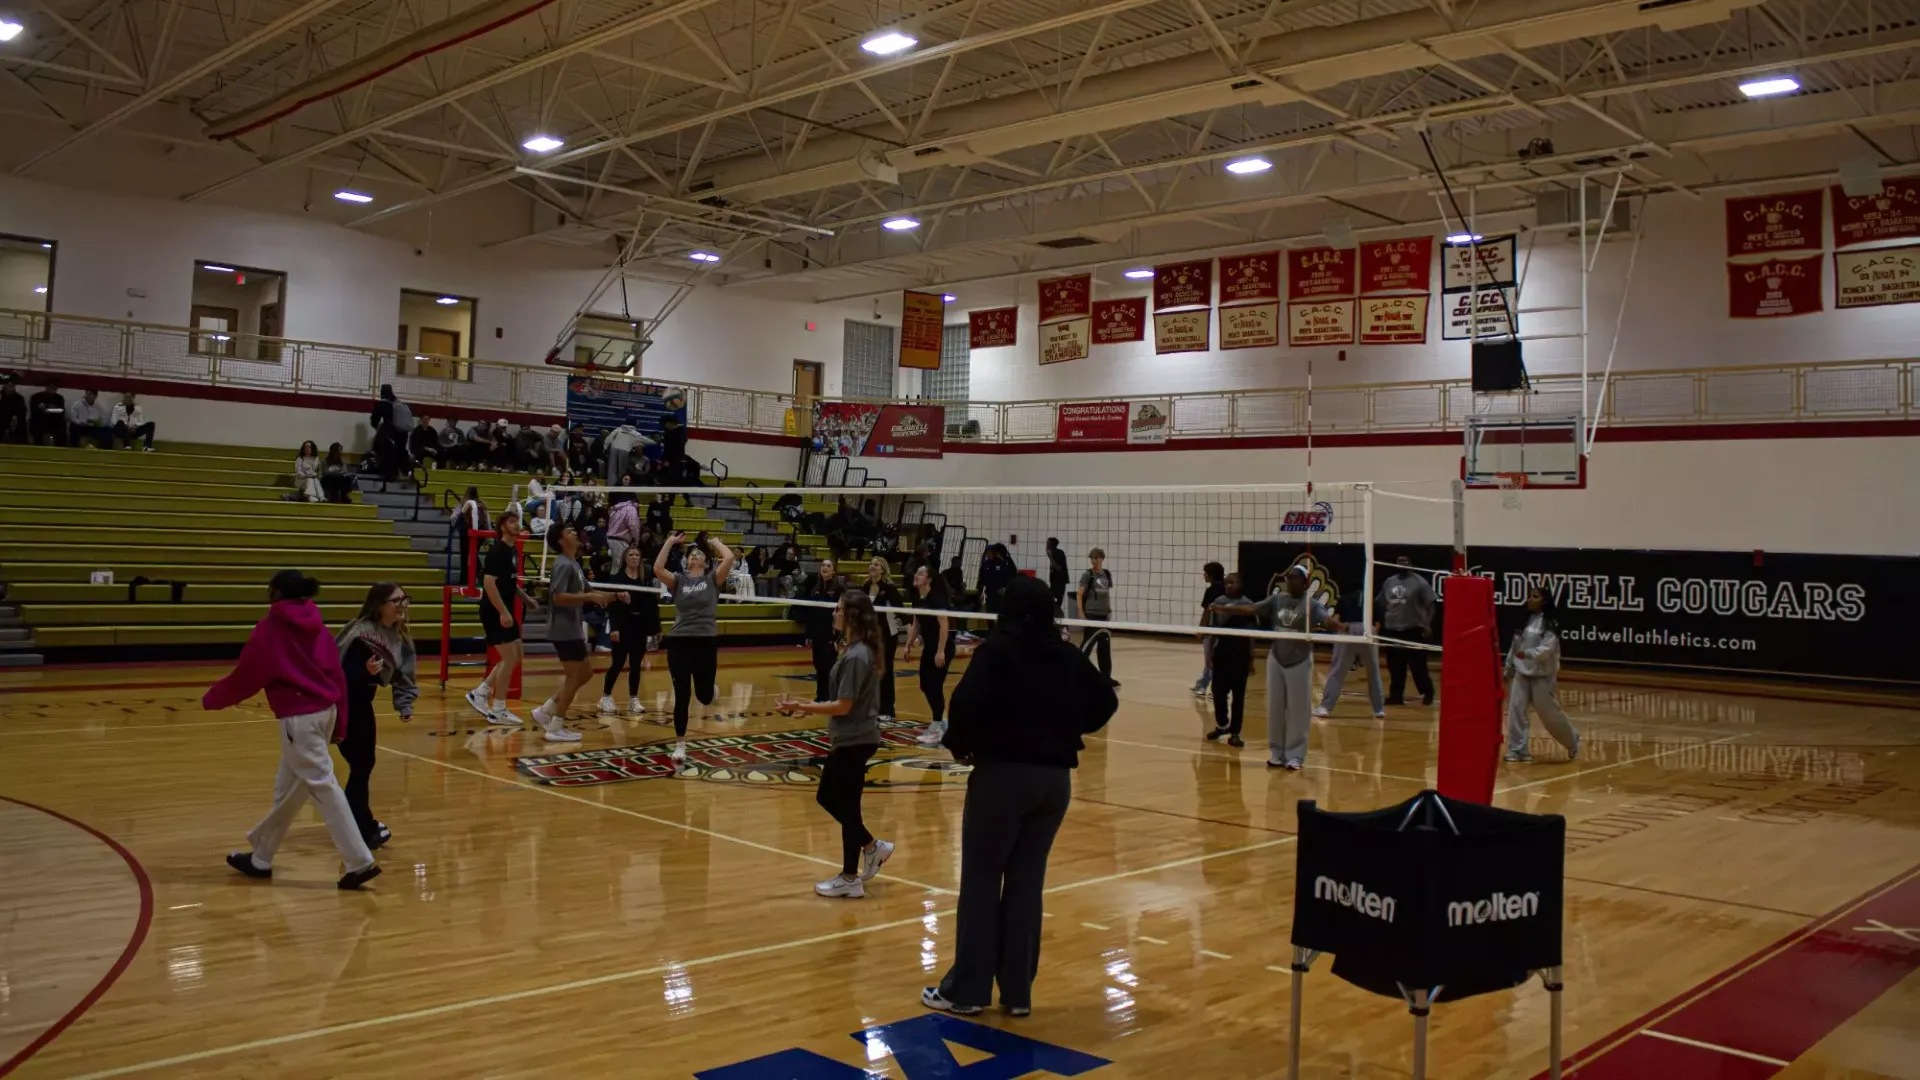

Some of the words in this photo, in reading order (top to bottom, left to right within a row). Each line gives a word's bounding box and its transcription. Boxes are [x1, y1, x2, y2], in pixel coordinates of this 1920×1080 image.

[1848, 186, 1917, 210] C..C.C.
[1062, 405, 1126, 415] CONGRATULATIONS
[1283, 511, 1327, 524] CACC
[1657, 577, 1867, 621] COUGARS
[1561, 625, 1757, 651] caldwellathletics.com
[1314, 875, 1397, 923] molten
[1447, 891, 1541, 927] molten
